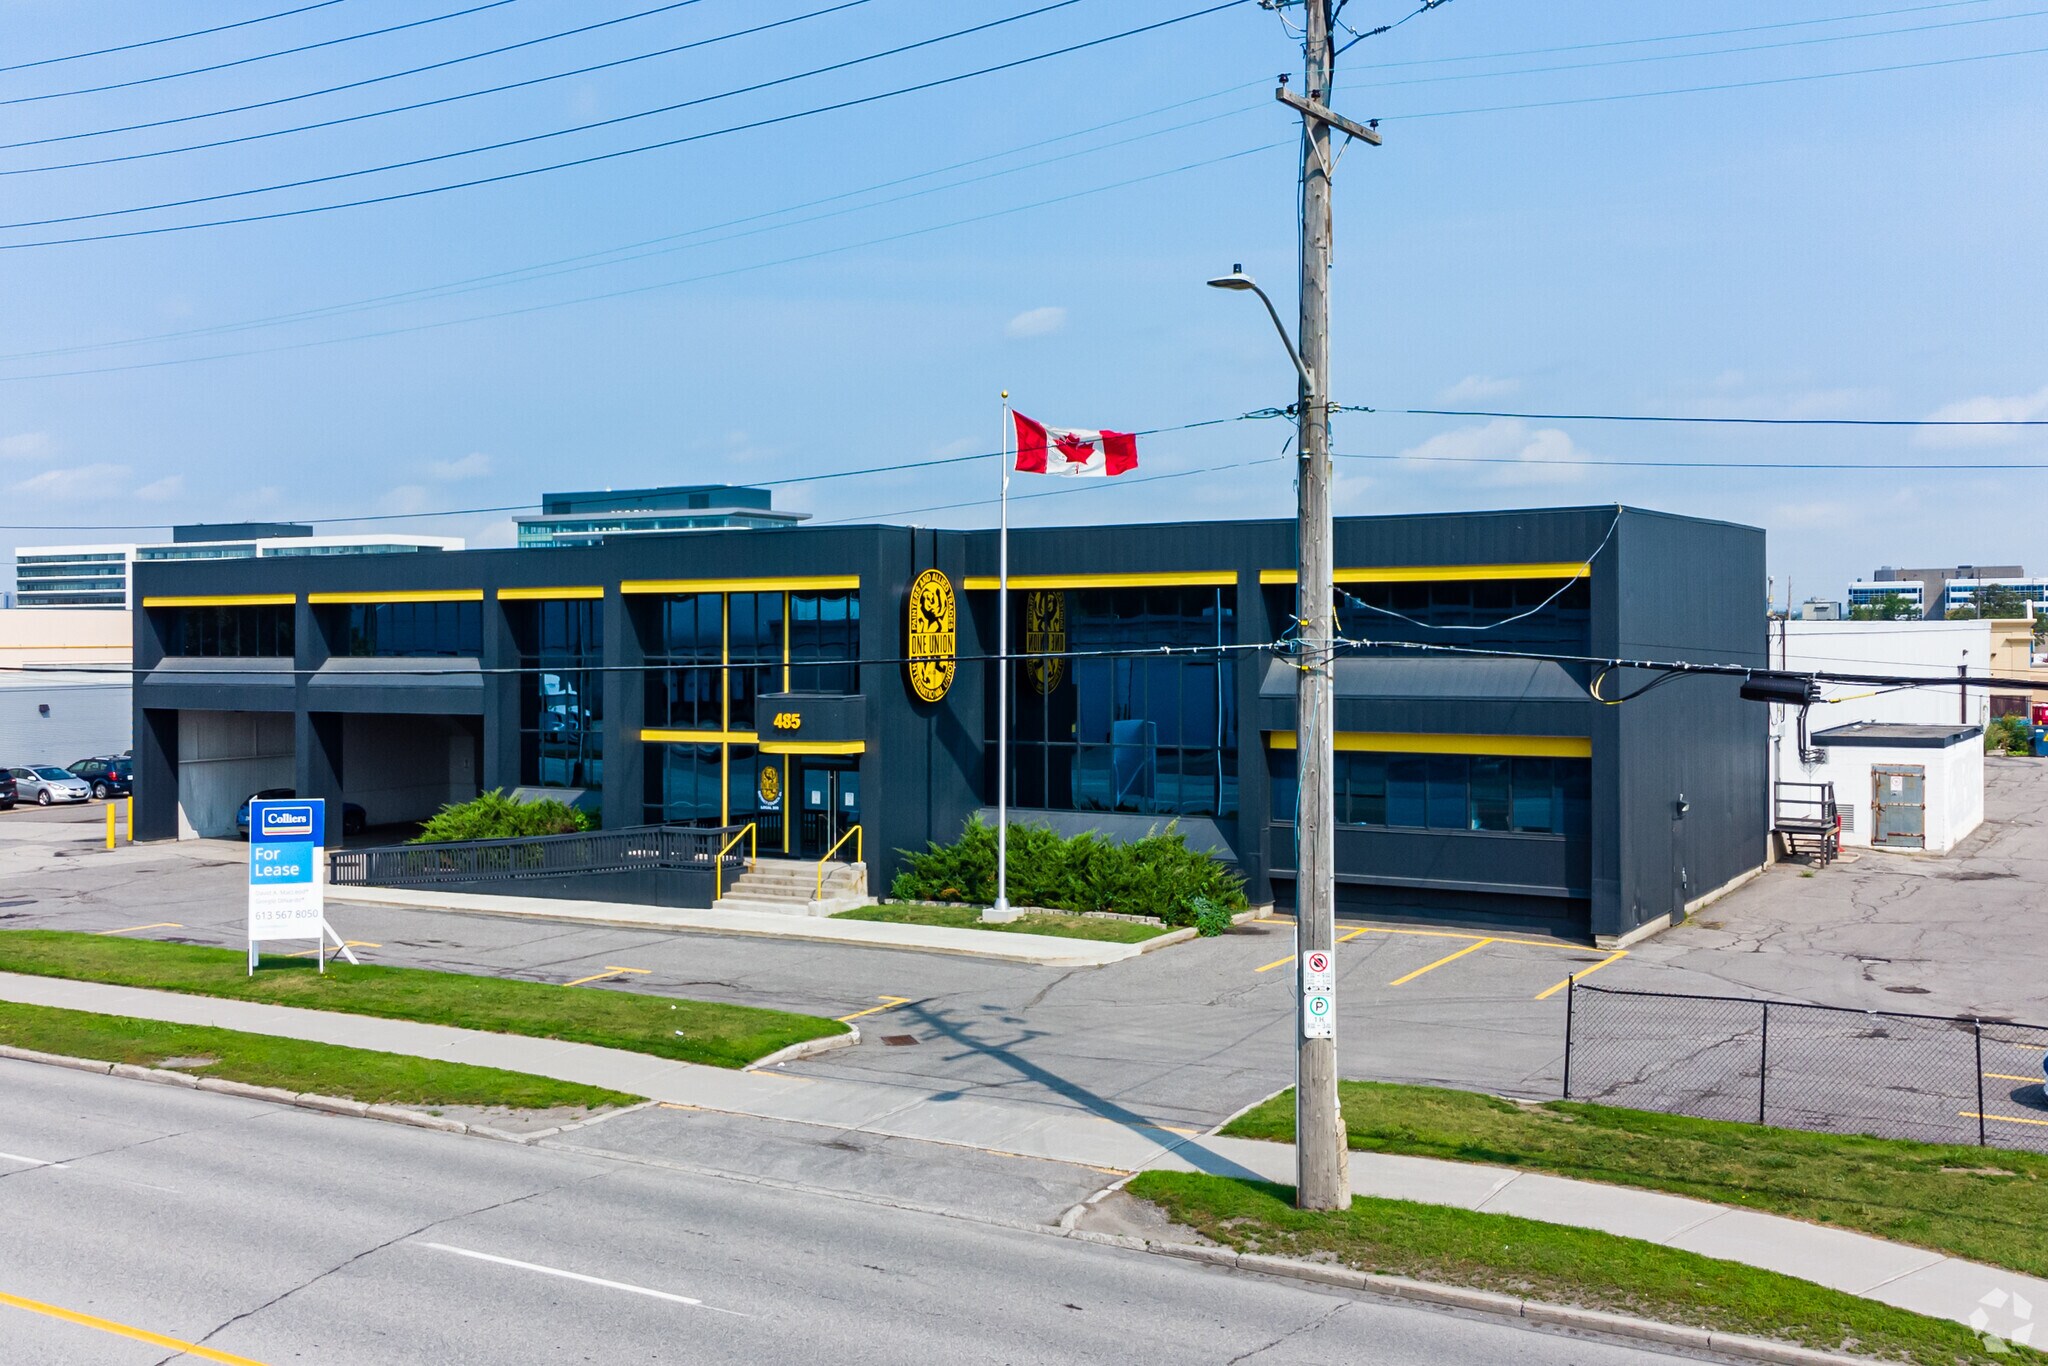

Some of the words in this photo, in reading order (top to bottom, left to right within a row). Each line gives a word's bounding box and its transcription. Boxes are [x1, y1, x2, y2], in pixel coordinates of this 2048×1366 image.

[911, 585, 921, 630] PAINTERS
[919, 573, 932, 588] AND
[932, 573, 950, 592] ALLIED
[912, 635, 926, 654] ONE
[929, 634, 953, 653] UNION
[773, 713, 800, 729] 485
[268, 813, 306, 823] Colliers
[255, 847, 280, 860] For
[255, 864, 299, 877] Lease
[255, 911, 273, 921] 613
[275, 910, 293, 919] 567
[295, 909, 319, 919] 8050
